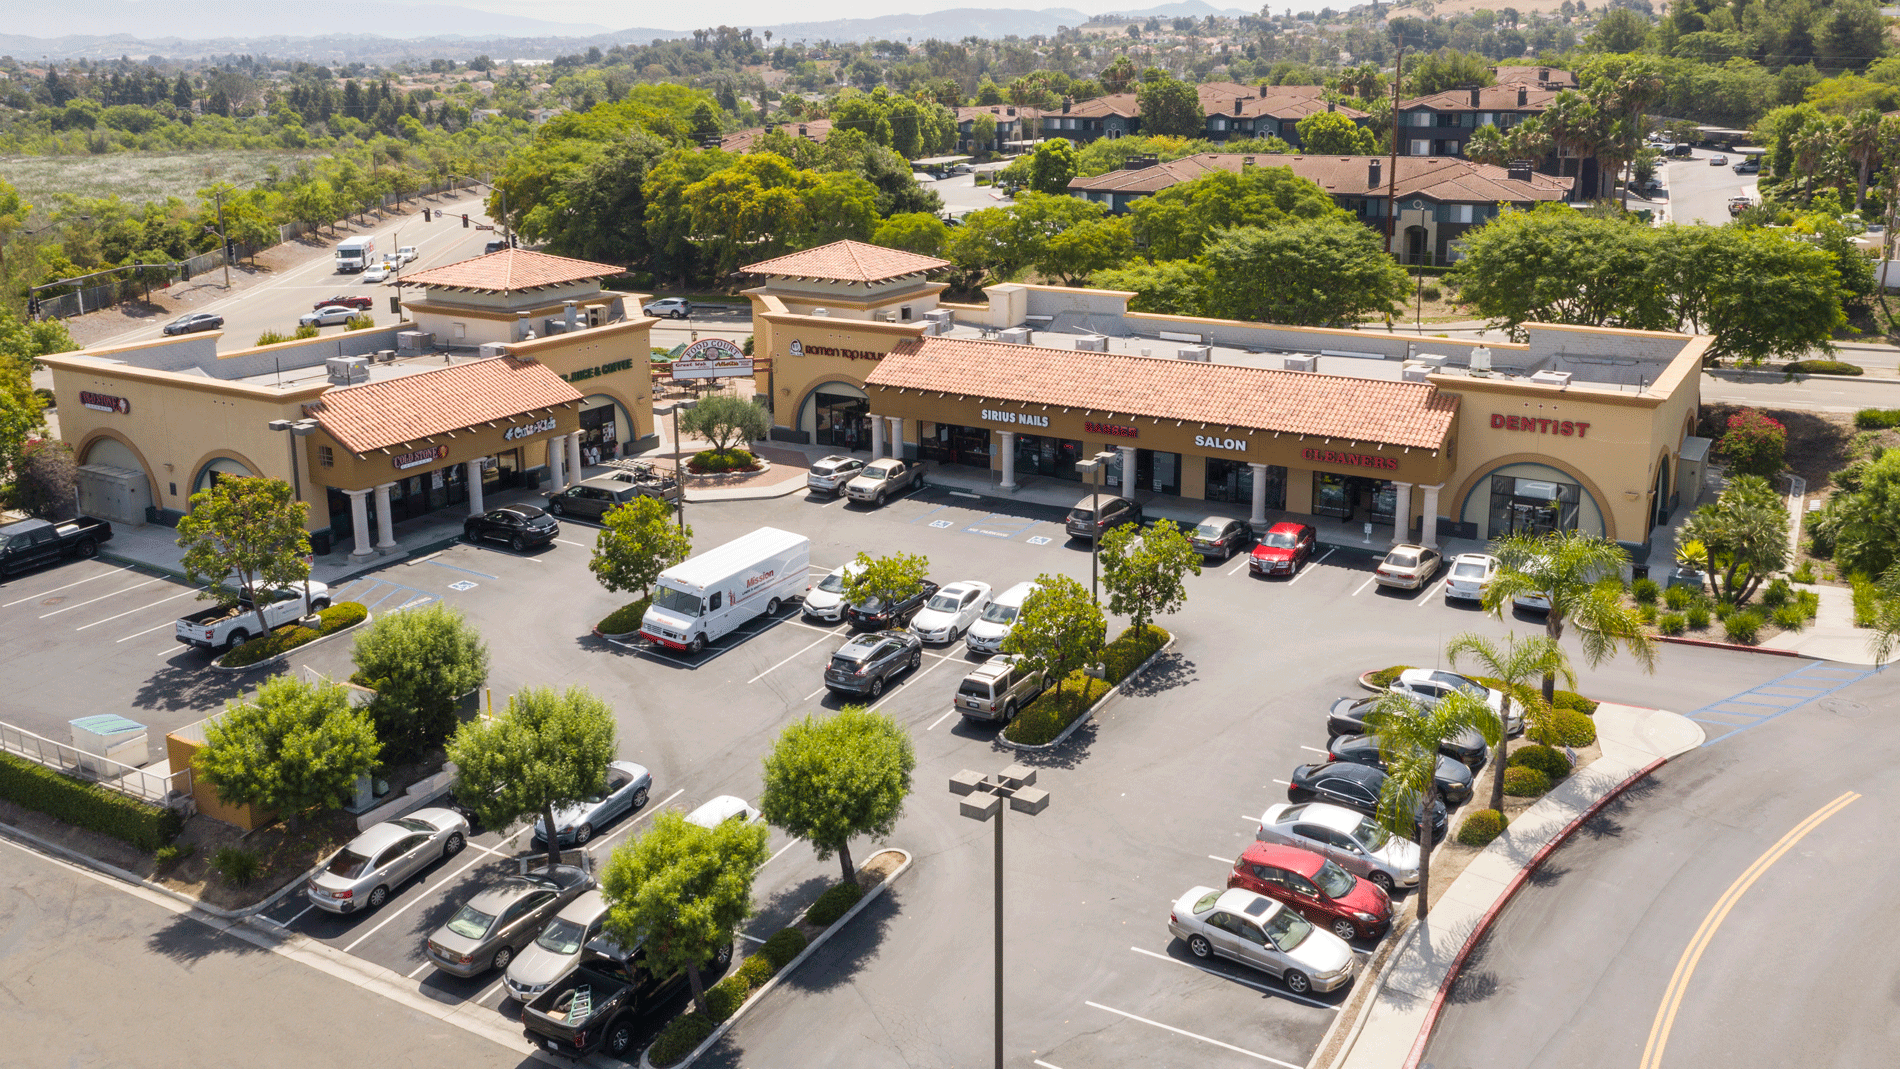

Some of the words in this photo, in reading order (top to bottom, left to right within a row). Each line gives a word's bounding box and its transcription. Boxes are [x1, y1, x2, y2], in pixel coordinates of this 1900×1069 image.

[686, 341, 709, 358] FOOD
[710, 340, 740, 356] COURT
[569, 367, 595, 382] JUICE
[594, 366, 602, 377] &
[601, 358, 634, 375] COFFEE
[981, 408, 1016, 423] SIRIUS
[1018, 413, 1049, 427] NAILS
[1490, 413, 1590, 438] DENTIST
[1194, 435, 1247, 451] SALON
[392, 452, 414, 469] COLD
[414, 446, 438, 461] STONE
[1301, 448, 1398, 470] CLEANERS
[746, 569, 775, 588] Mission
